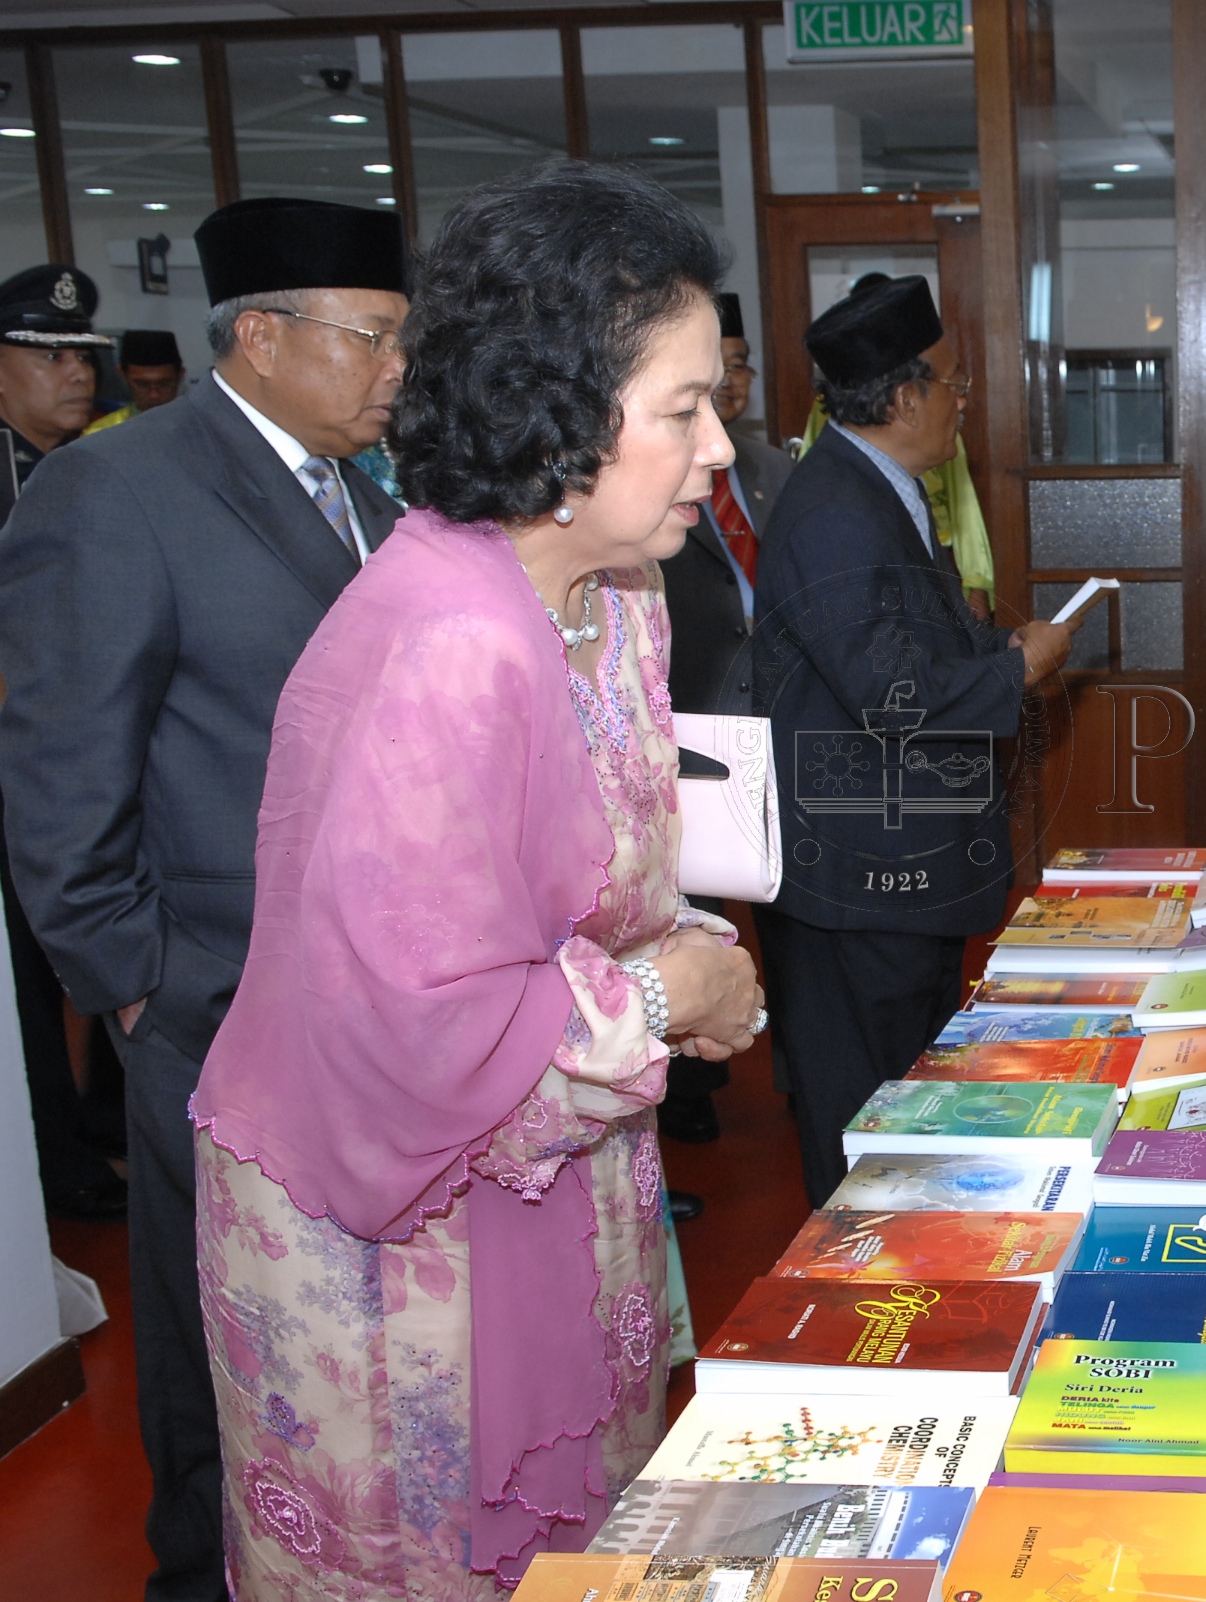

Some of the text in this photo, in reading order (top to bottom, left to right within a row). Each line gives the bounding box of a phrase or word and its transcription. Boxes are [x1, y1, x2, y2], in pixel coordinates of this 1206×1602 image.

[801, 3, 925, 44] KELUAR
[1041, 1166, 1072, 1212] PERSEKITARAN
[1001, 1221, 1026, 1249] Sekitar
[1002, 1249, 1033, 1273] Alam
[872, 1284, 940, 1364] KESANTUNAN
[856, 1337, 878, 1364] MELAYU
[1075, 1355, 1176, 1368] Program
[1090, 1368, 1151, 1378] SOBI
[1098, 1385, 1144, 1394] Deria
[1055, 1411, 1106, 1419] HIDUNG
[1060, 1401, 1115, 1409] TELINGA
[956, 1416, 976, 1442] BASIC
[873, 1425, 913, 1479] CHEMISTRY
[935, 1446, 950, 1458] OF
[826, 1504, 866, 1535] Benih
[1010, 1526, 1042, 1579] LAURENT METZGER
